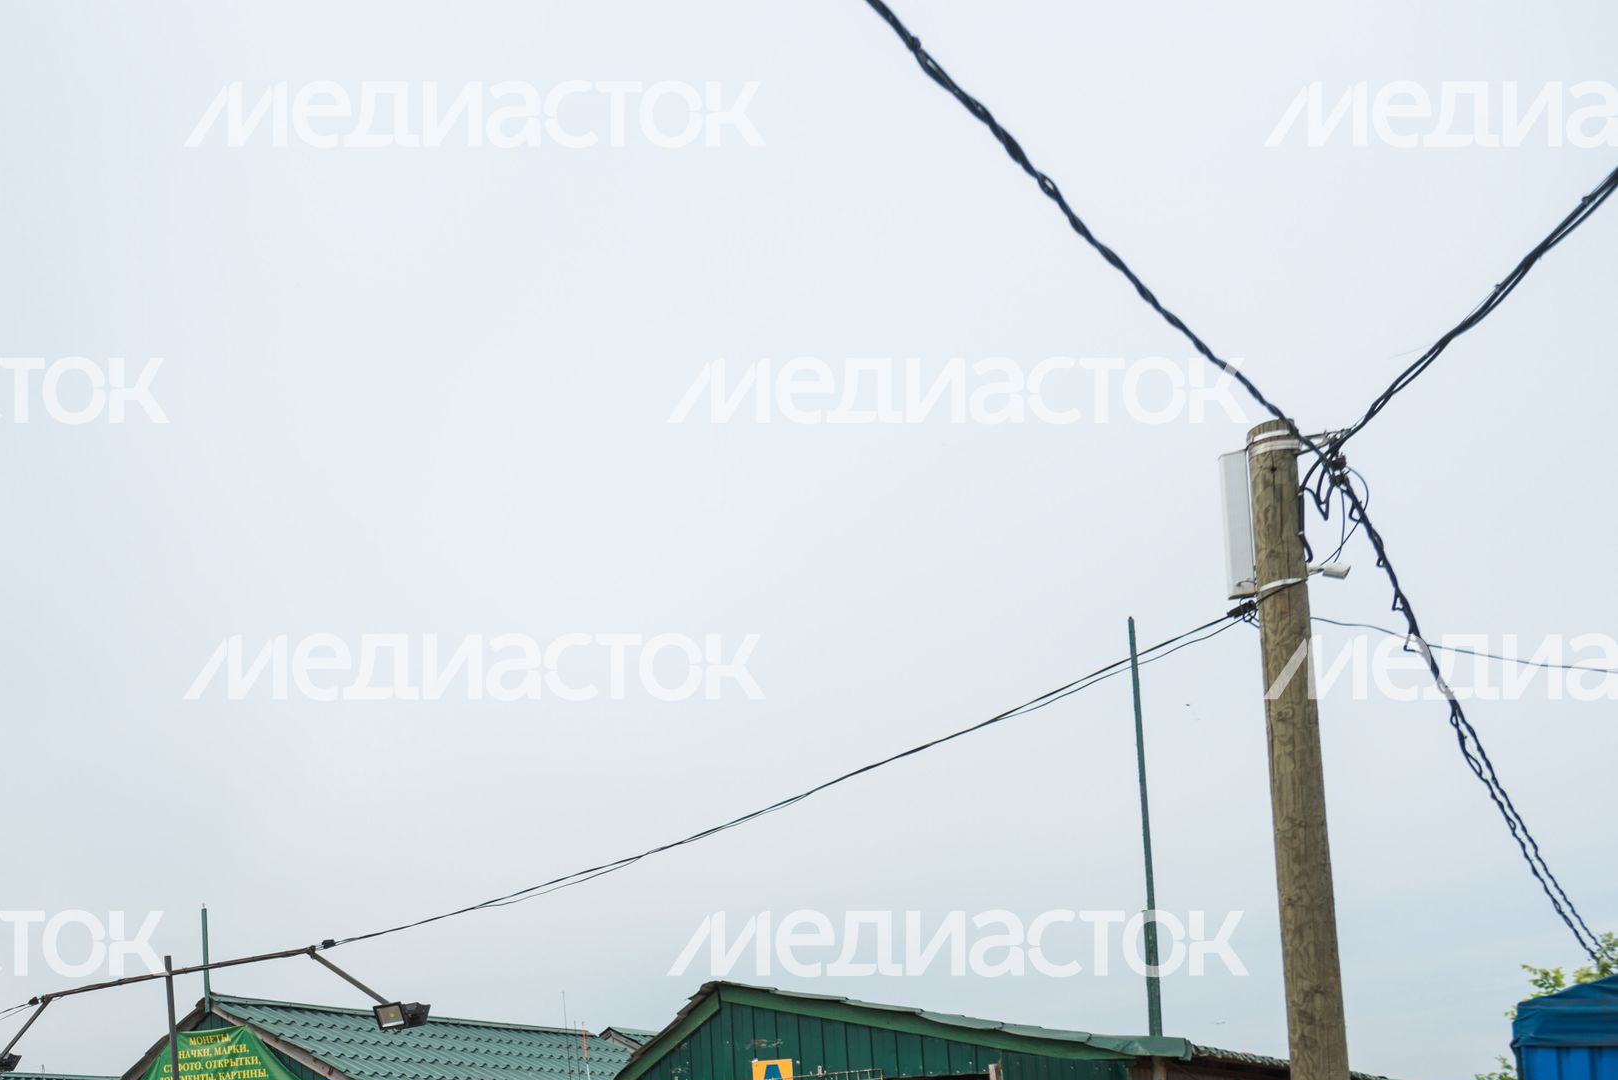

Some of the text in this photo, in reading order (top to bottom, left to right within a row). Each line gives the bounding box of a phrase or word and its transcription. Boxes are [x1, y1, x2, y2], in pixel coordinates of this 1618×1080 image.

[190, 1033, 232, 1046] МОНЕТЫ,
[178, 1044, 249, 1059] НАЧКИ, МАРКИ,
[206, 1056, 261, 1070] ОТКРЫТКИ,
[218, 1069, 268, 1080] КАРТИНЫ,
